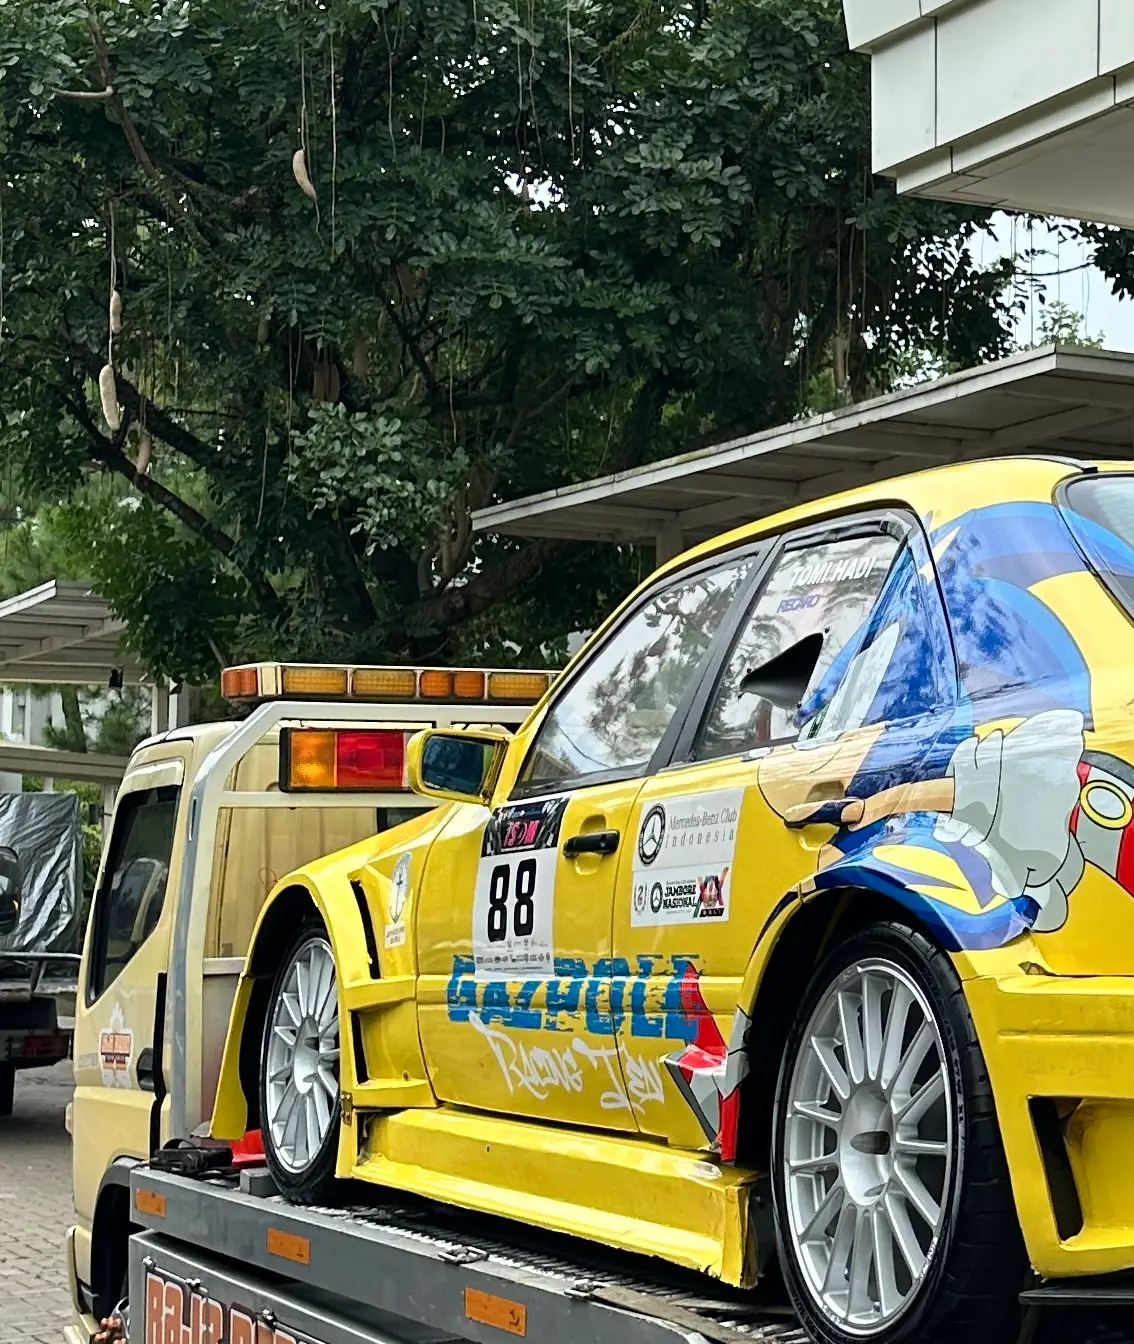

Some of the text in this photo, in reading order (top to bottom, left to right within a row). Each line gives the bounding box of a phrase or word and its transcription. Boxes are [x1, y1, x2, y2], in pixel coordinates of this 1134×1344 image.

[720, 807, 738, 824] Club
[665, 827, 735, 849] Indonesia
[487, 858, 537, 943] 88
